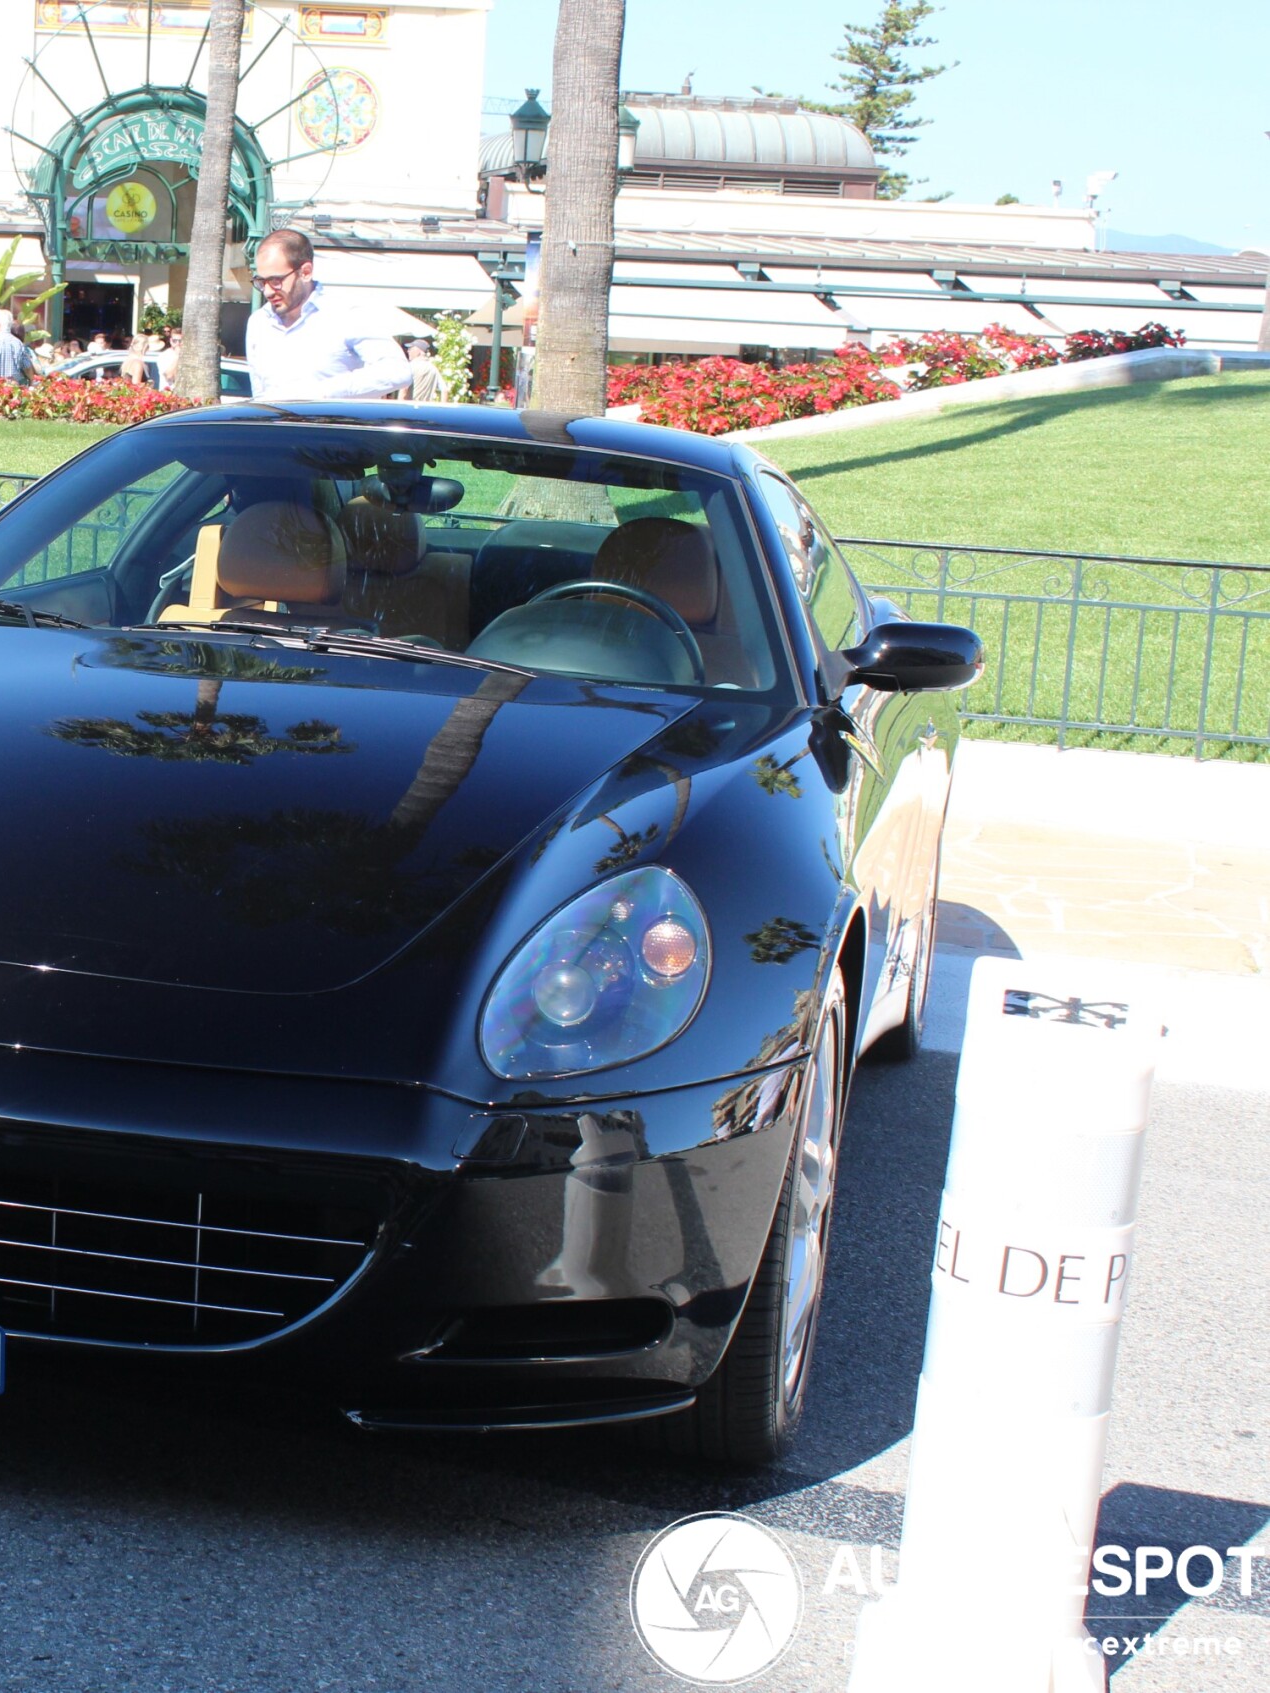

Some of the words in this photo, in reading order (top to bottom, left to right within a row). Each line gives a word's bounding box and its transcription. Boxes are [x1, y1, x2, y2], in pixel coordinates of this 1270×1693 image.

[148, 122, 170, 141] DE
[114, 210, 148, 218] CASINO
[89, 243, 179, 264] CASINO
[999, 1246, 1085, 1304] DE
